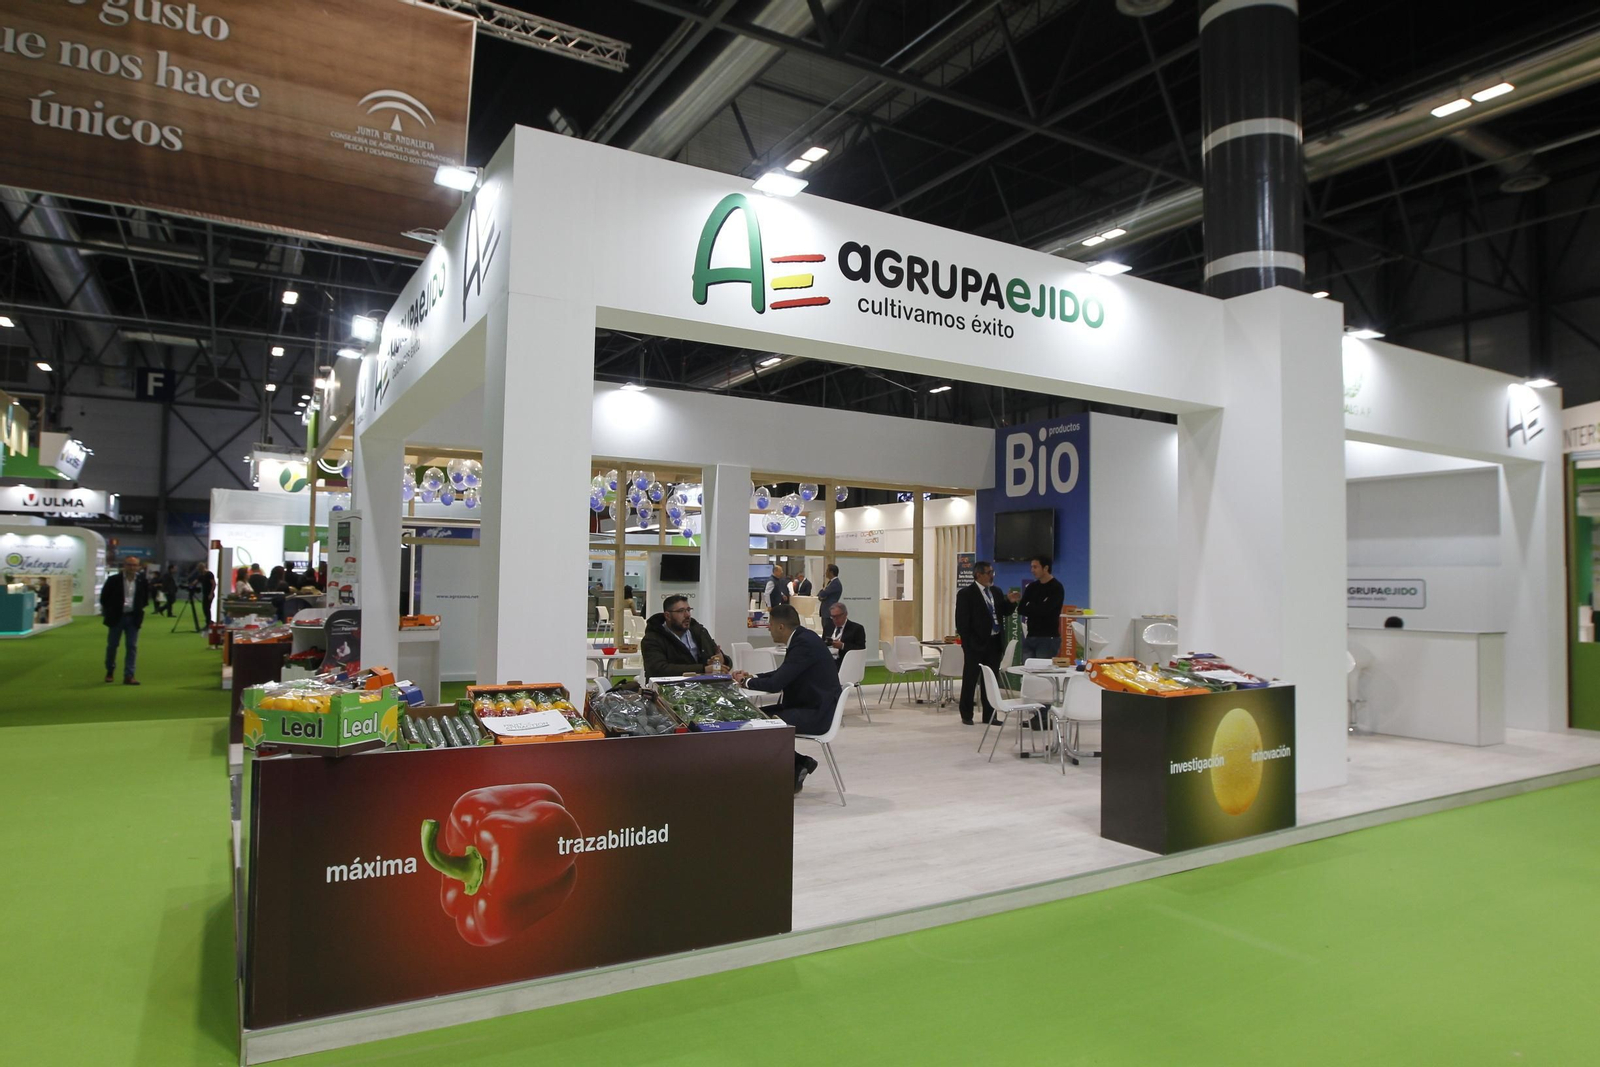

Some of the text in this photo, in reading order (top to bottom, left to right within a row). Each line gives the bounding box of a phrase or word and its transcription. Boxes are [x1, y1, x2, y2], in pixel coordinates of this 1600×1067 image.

[59, 40, 143, 81] nos
[154, 50, 260, 108] hace
[28, 89, 183, 151] únicos
[355, 125, 380, 139] JUNTA
[383, 131, 392, 141] DE
[368, 139, 378, 147] DE
[344, 142, 364, 152] PESCA
[369, 147, 408, 162] DESARROLLO
[857, 296, 1015, 339] cultivamos éxito
[147, 372, 165, 396] F
[1048, 423, 1080, 437] productos
[1006, 427, 1080, 498] Bio
[43, 497, 85, 508] ULMA
[20, 555, 70, 571] Integral
[281, 716, 324, 739] Leal
[343, 712, 378, 738] Leal
[1170, 753, 1225, 775] investigación
[1251, 744, 1291, 762] innovación
[557, 823, 669, 856] trazabilidad
[325, 855, 417, 883] máxima
